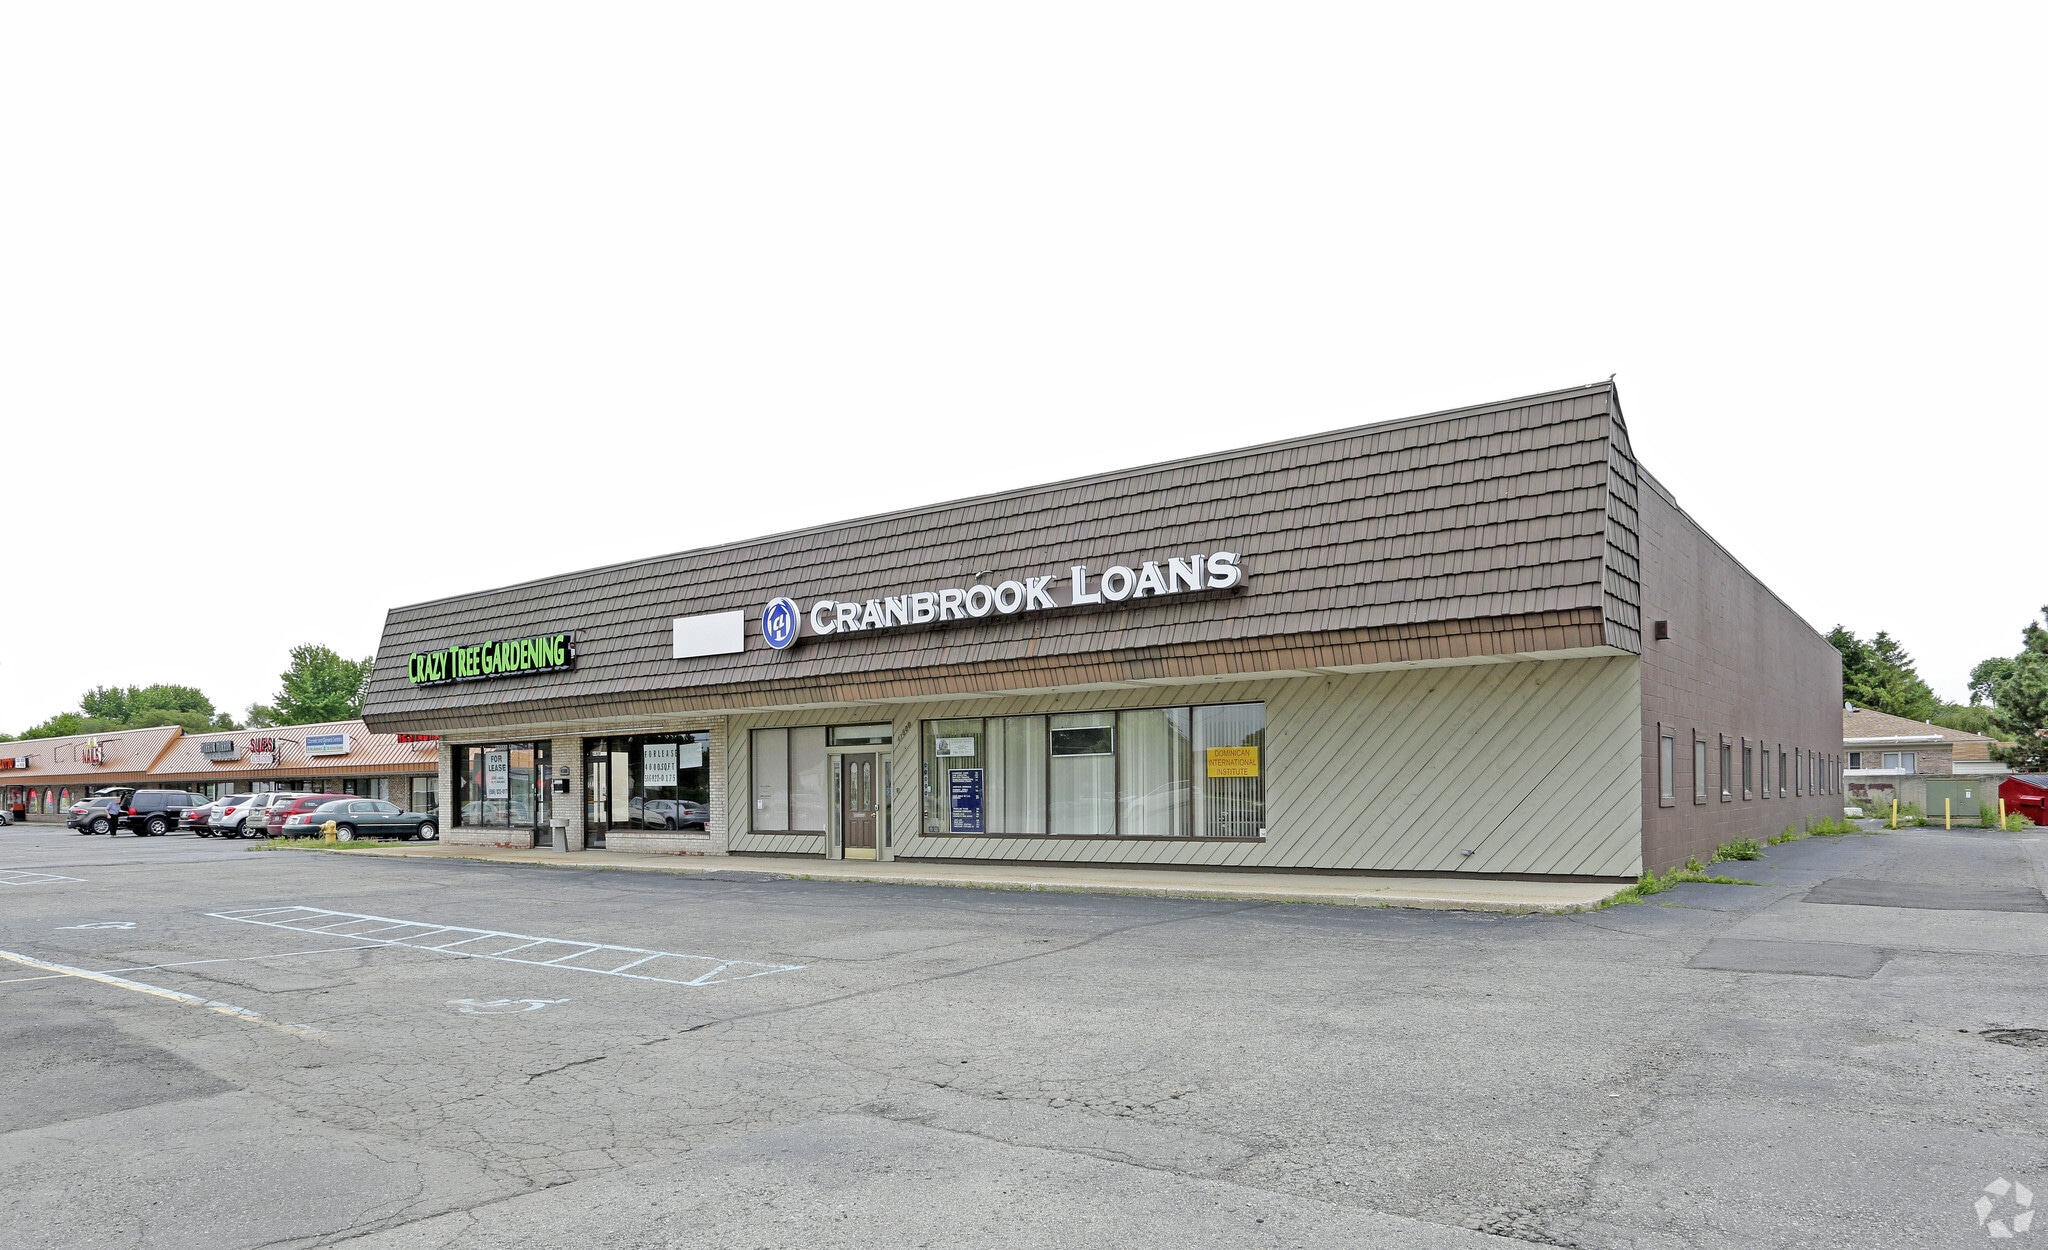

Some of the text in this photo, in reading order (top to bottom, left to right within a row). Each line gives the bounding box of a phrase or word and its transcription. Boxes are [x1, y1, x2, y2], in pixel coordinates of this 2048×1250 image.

[810, 551, 1242, 635] CRANBROOK LOANS
[408, 634, 565, 684] CRAZY TREE GARDENING
[250, 737, 273, 753] SUE'S
[83, 747, 102, 764] NAILS
[491, 755, 502, 763] FOR
[1214, 749, 1250, 757] DOMINICAN
[488, 764, 506, 772] LEASE
[1208, 758, 1257, 766] INTERNATIONAL
